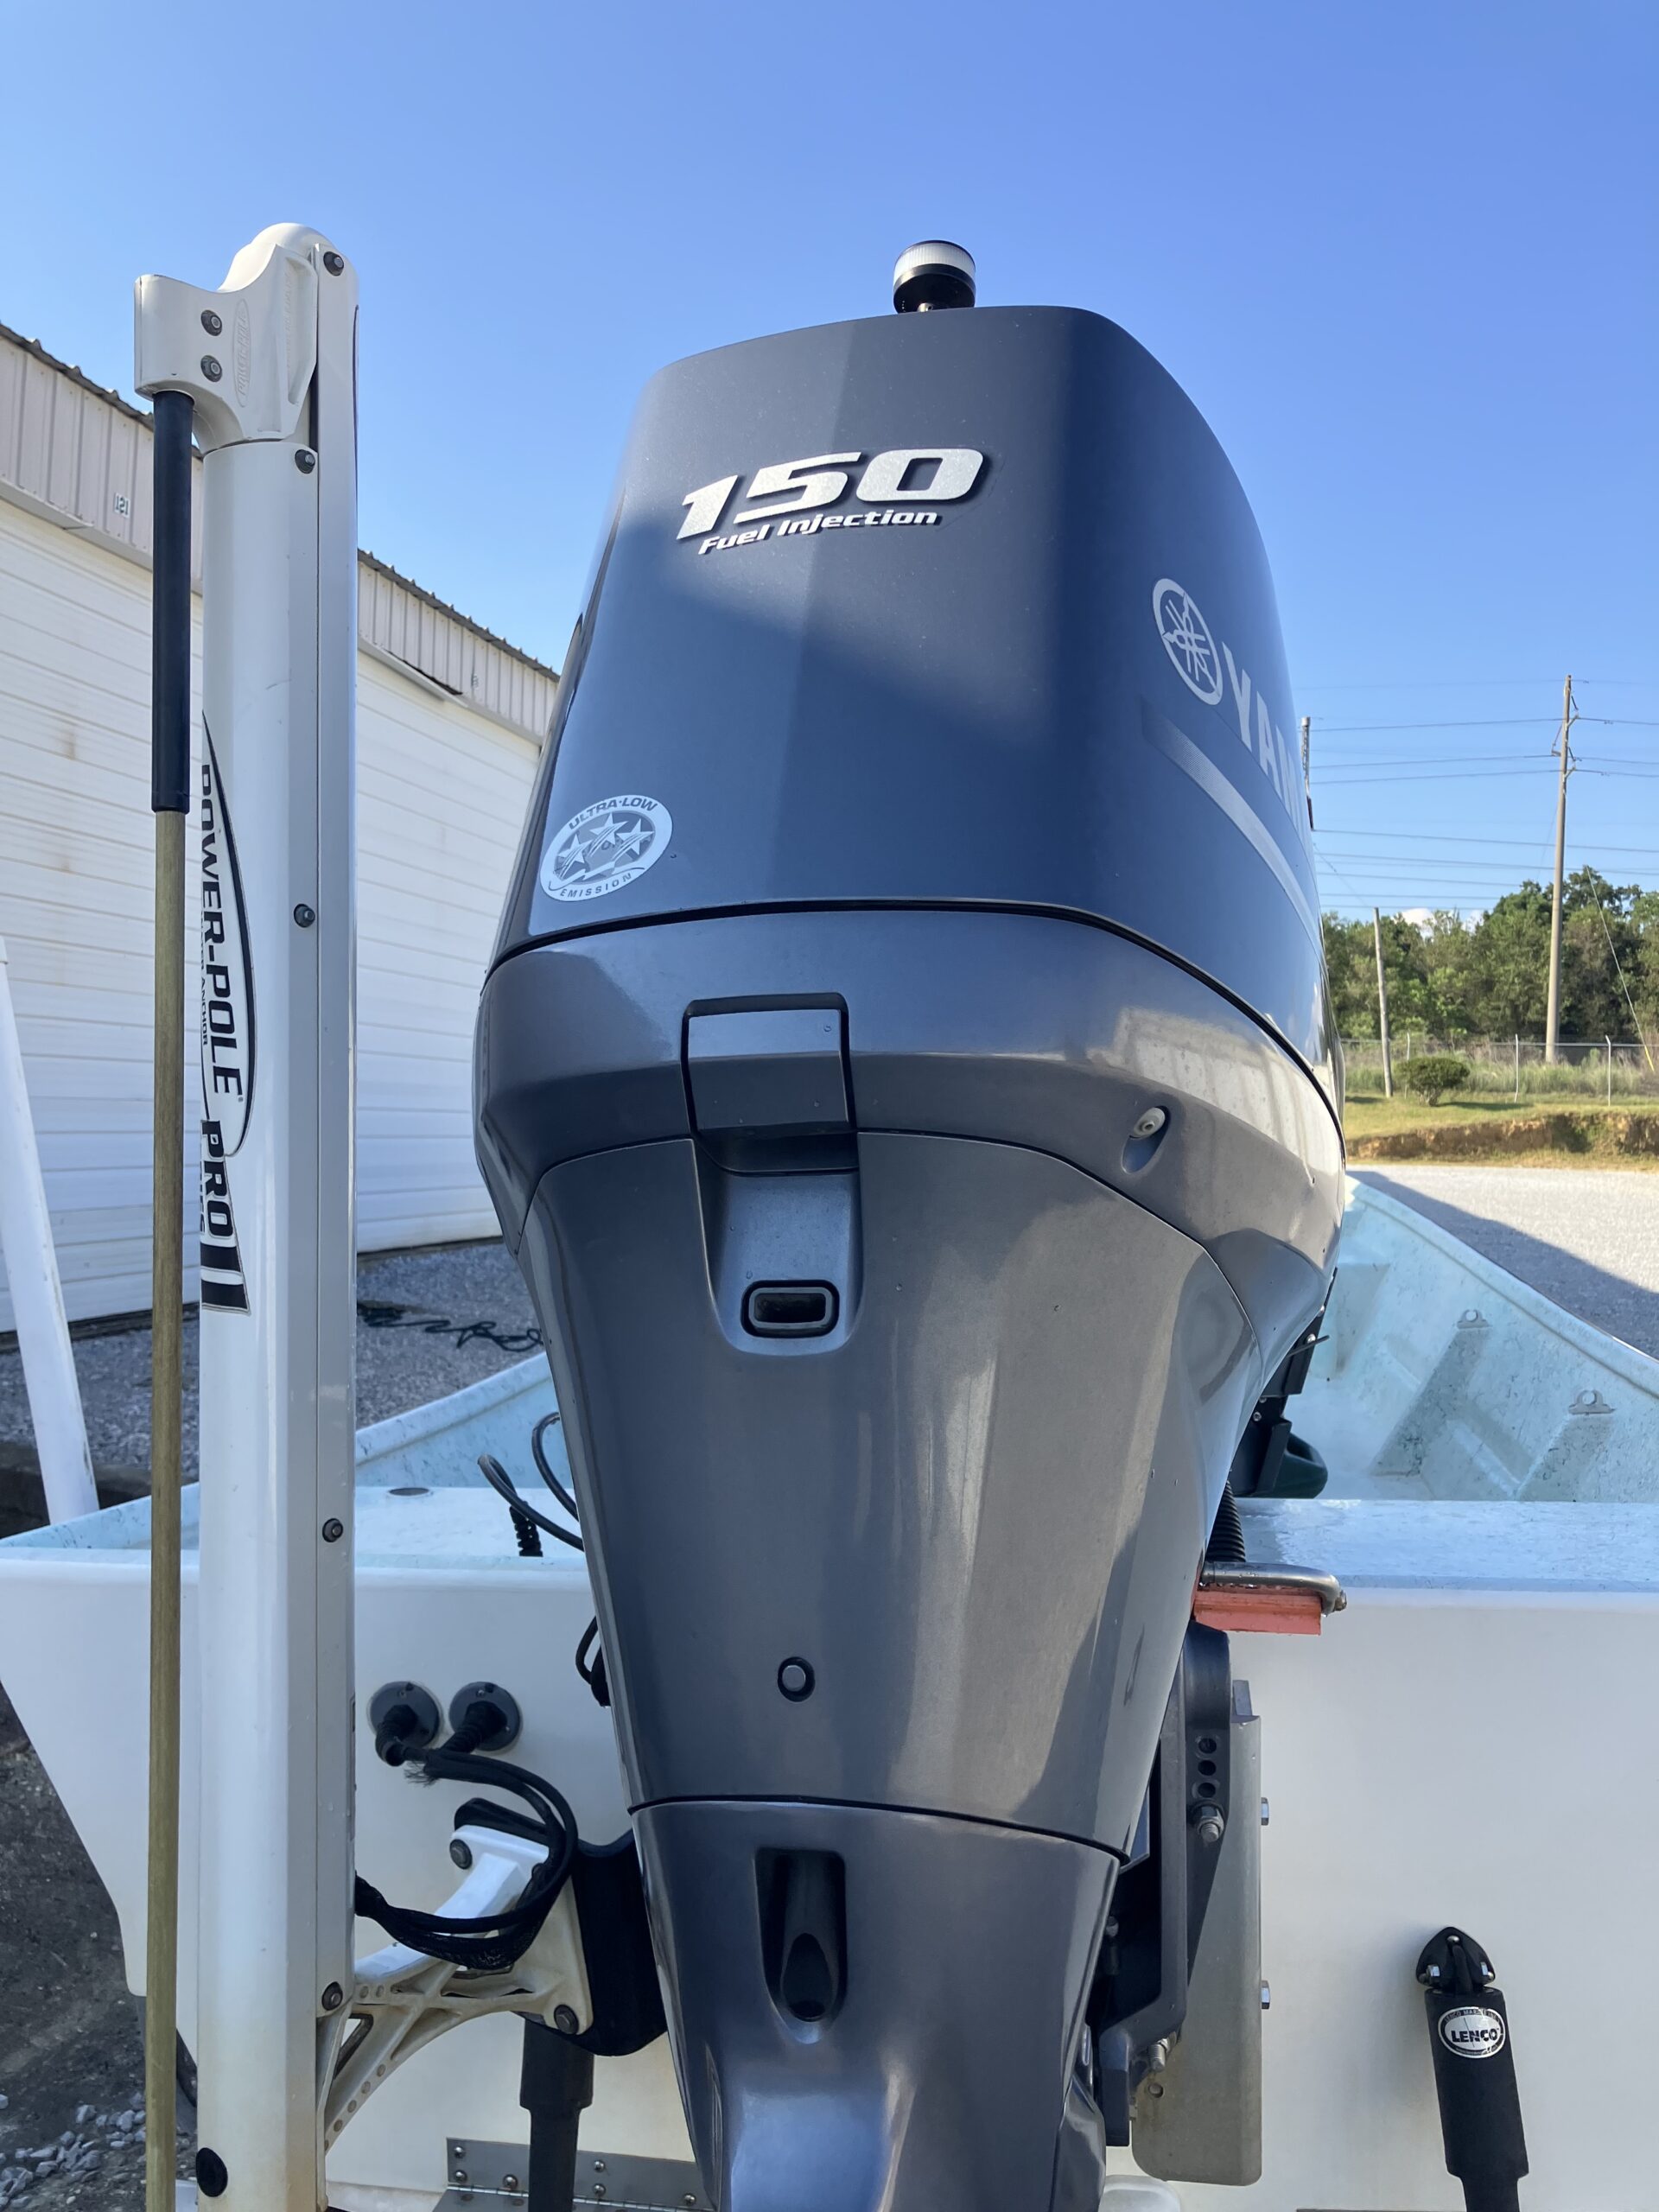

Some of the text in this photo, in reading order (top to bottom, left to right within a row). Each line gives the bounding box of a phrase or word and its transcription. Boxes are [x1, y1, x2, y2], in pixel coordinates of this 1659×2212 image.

[677, 448, 984, 540] 150
[697, 510, 938, 555] Fuel Injection
[560, 872, 632, 898] EMISSION
[201, 1121, 234, 1237] PRO
[1451, 2028, 1498, 2043] LENCO
